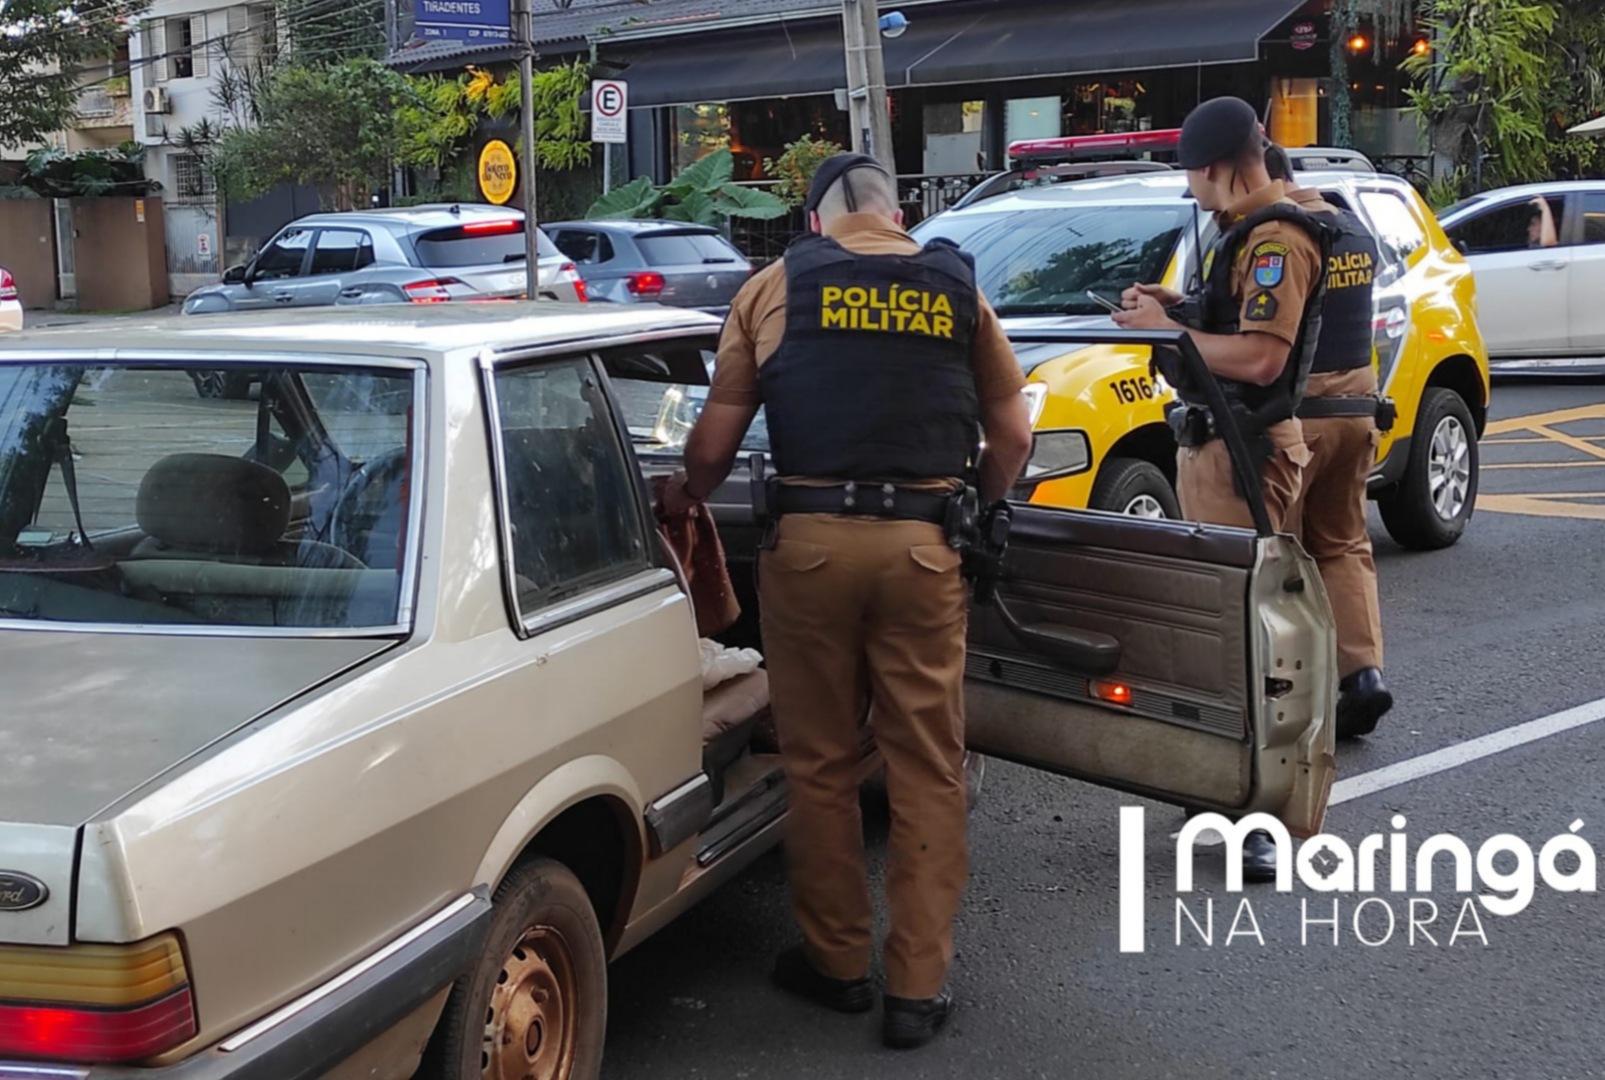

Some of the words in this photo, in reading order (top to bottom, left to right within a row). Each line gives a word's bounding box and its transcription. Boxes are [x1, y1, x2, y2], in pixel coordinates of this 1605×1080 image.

[423, 1, 481, 14] TIRADENTES
[603, 90, 617, 110] E
[1328, 251, 1373, 272] OLÍCIA
[822, 284, 954, 317] POLÍCIA
[822, 307, 954, 339] MILITAR
[0, 882, 25, 902] rd
